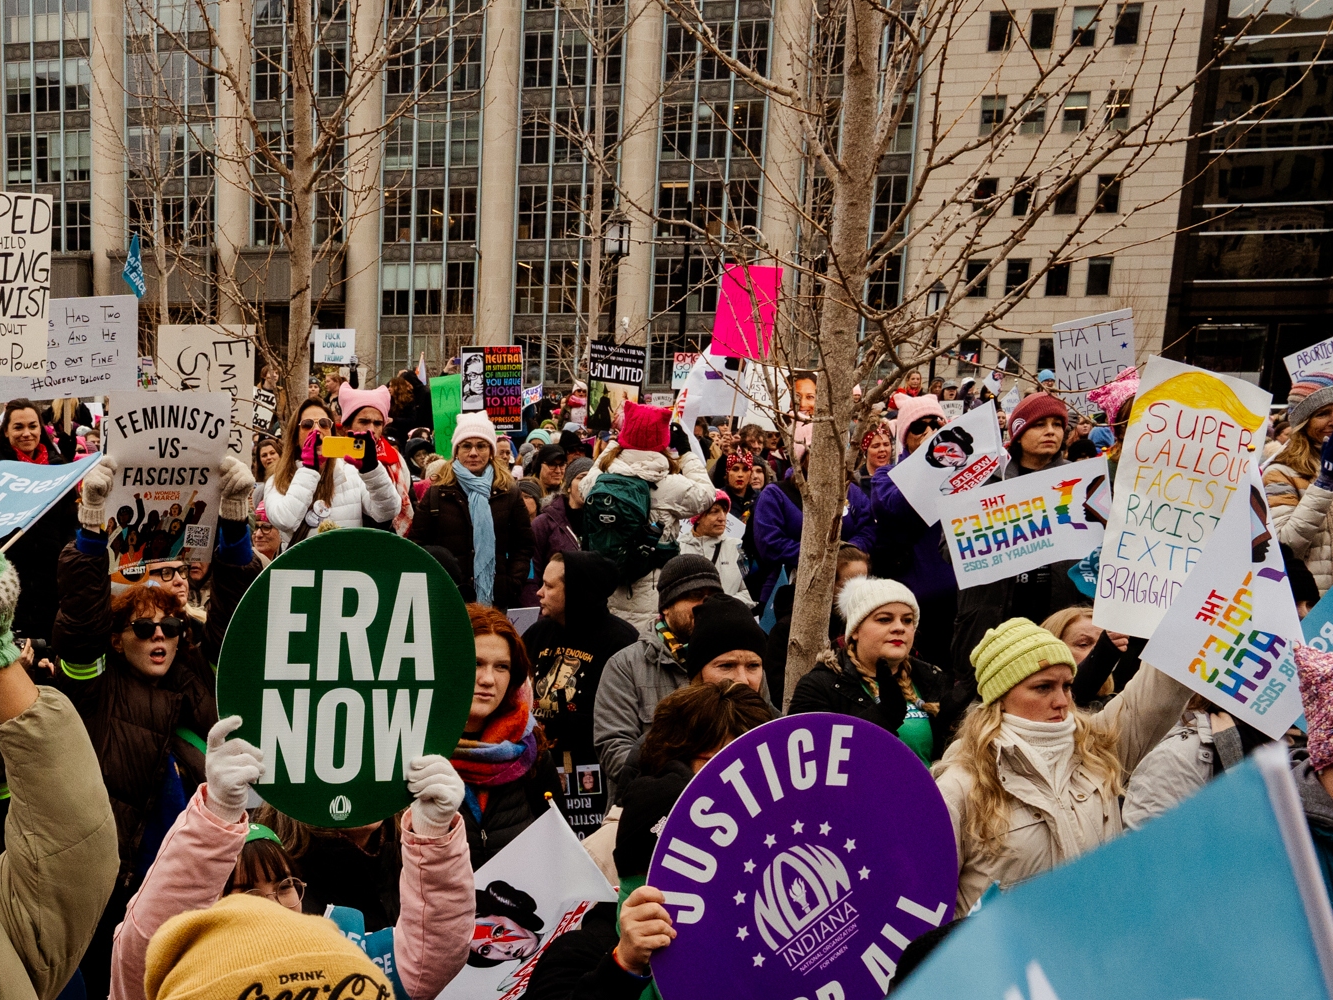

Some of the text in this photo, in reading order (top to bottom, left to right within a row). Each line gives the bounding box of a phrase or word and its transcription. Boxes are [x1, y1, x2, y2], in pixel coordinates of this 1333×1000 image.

[66, 307, 90, 325] HAD
[68, 331, 88, 344] AND
[102, 328, 116, 341] HE
[1058, 318, 1126, 349] HATE
[322, 341, 347, 349] DONALD
[10, 342, 47, 372] Power
[324, 354, 344, 363] TRUMP
[486, 354, 522, 364] NEUTRAL
[675, 363, 691, 371] GO
[1062, 350, 1117, 372] WILL
[590, 361, 643, 383] UNLIMITED
[674, 371, 689, 379] WT
[486, 386, 521, 396] CHOSEN
[487, 397, 521, 406] TO SIDE
[486, 407, 504, 415] WITH
[114, 405, 225, 440] FEMINISTS
[1146, 402, 1253, 454] SUPER
[122, 467, 210, 487] FASCISTS
[1133, 465, 1237, 513] FACIST
[264, 568, 435, 682] ERA
[258, 687, 434, 785] NOW
[661, 724, 855, 924] JUSTICE
[754, 843, 851, 951] NOW
[782, 901, 858, 967] INDIANA
[799, 923, 858, 972] NATIONAL ORGANIZATION
[819, 945, 848, 970] FOR WOMEN
[279, 970, 326, 985] DRINK
